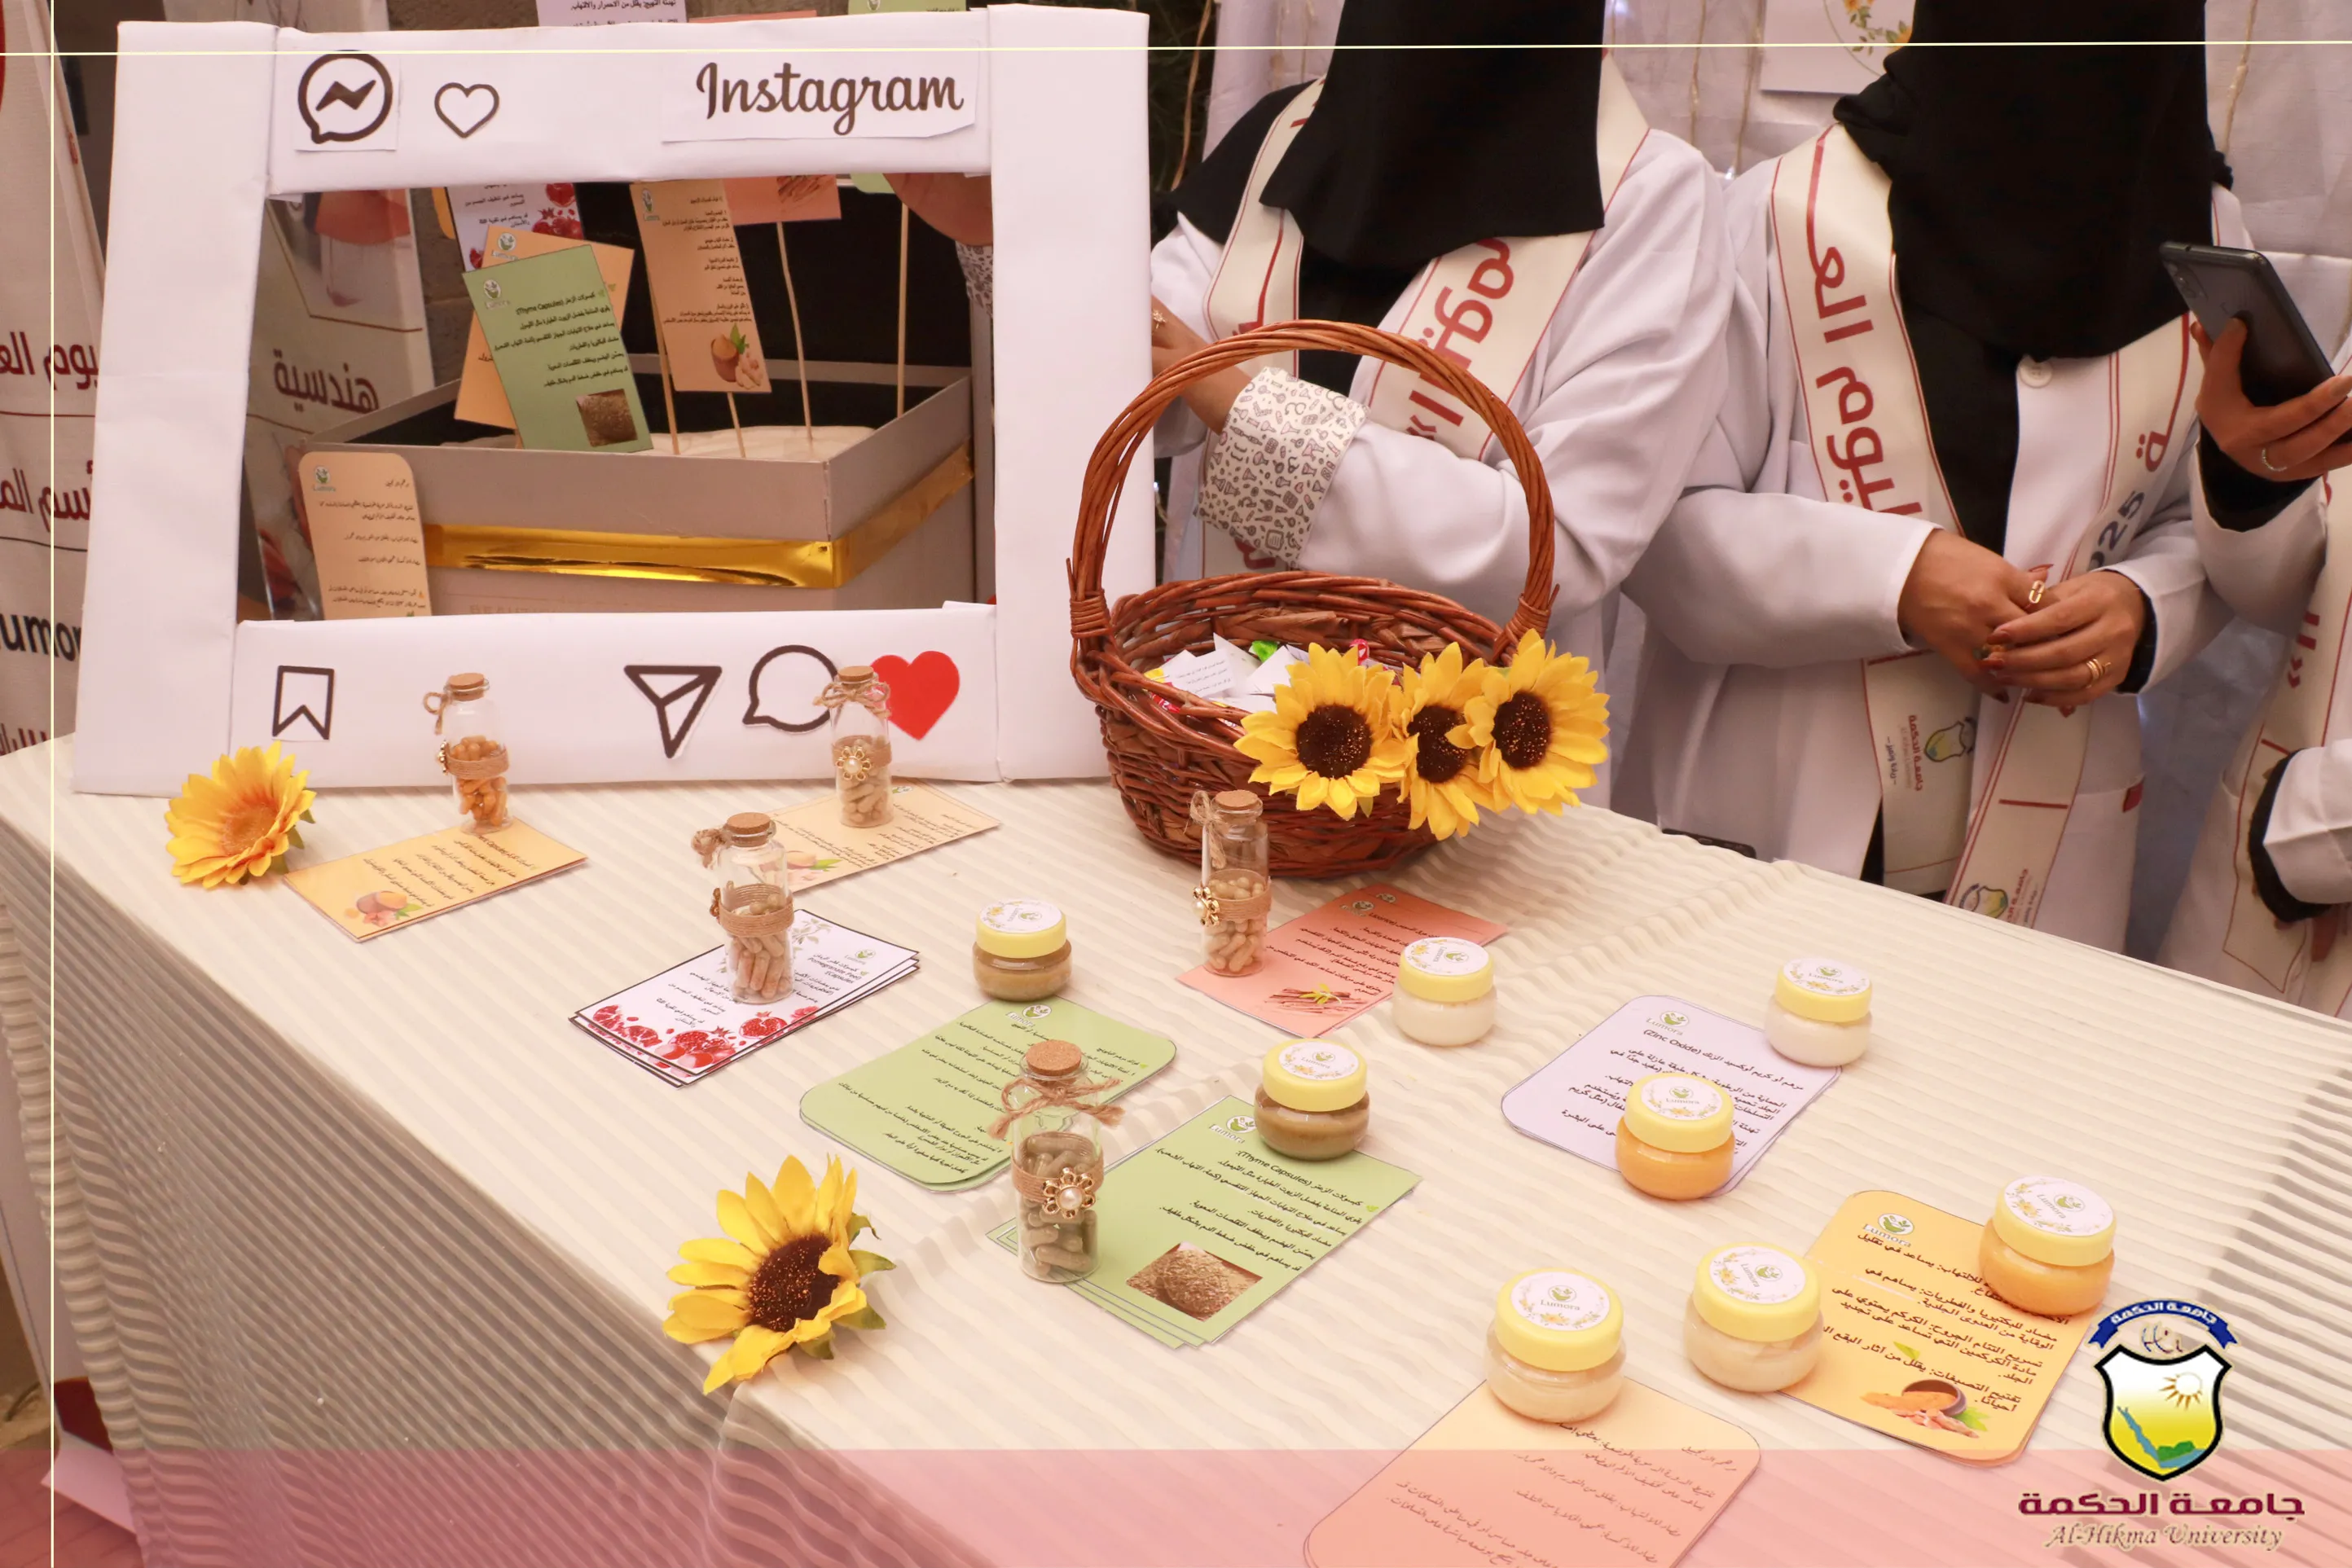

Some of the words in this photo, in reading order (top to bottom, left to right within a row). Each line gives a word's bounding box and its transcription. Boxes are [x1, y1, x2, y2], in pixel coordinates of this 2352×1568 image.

[697, 62, 965, 136] Instagram
[1208, 1123, 1246, 1144] Lumora
[2037, 1193, 2067, 1219] Lumora
[1862, 1223, 1912, 1248] Lumora
[1740, 1263, 1761, 1288] Lumora
[1865, 1268, 1883, 1276] في
[1882, 1276, 1917, 1292] يساهم
[1541, 1298, 1581, 1311] Lumora
[1840, 1302, 1872, 1315] تجديد
[1917, 1298, 1960, 1315] الجلدية.
[1919, 1289, 1976, 1314] والفطريات:
[1871, 1315, 1894, 1324] على
[1959, 1316, 1998, 1330] العدوى
[1979, 1309, 2024, 1329] للبكتيريا
[1897, 1324, 1932, 1339] تساعد
[1998, 1329, 2016, 1338] من
[2025, 1329, 2057, 1346] مضاد
[1933, 1338, 1959, 1349] التي
[2018, 1333, 2055, 1350] الوقاية
[1959, 1346, 2011, 1367] الكركمين
[2011, 1364, 2037, 1377] مادة
[1998, 1373, 2033, 1385] الجلد.
